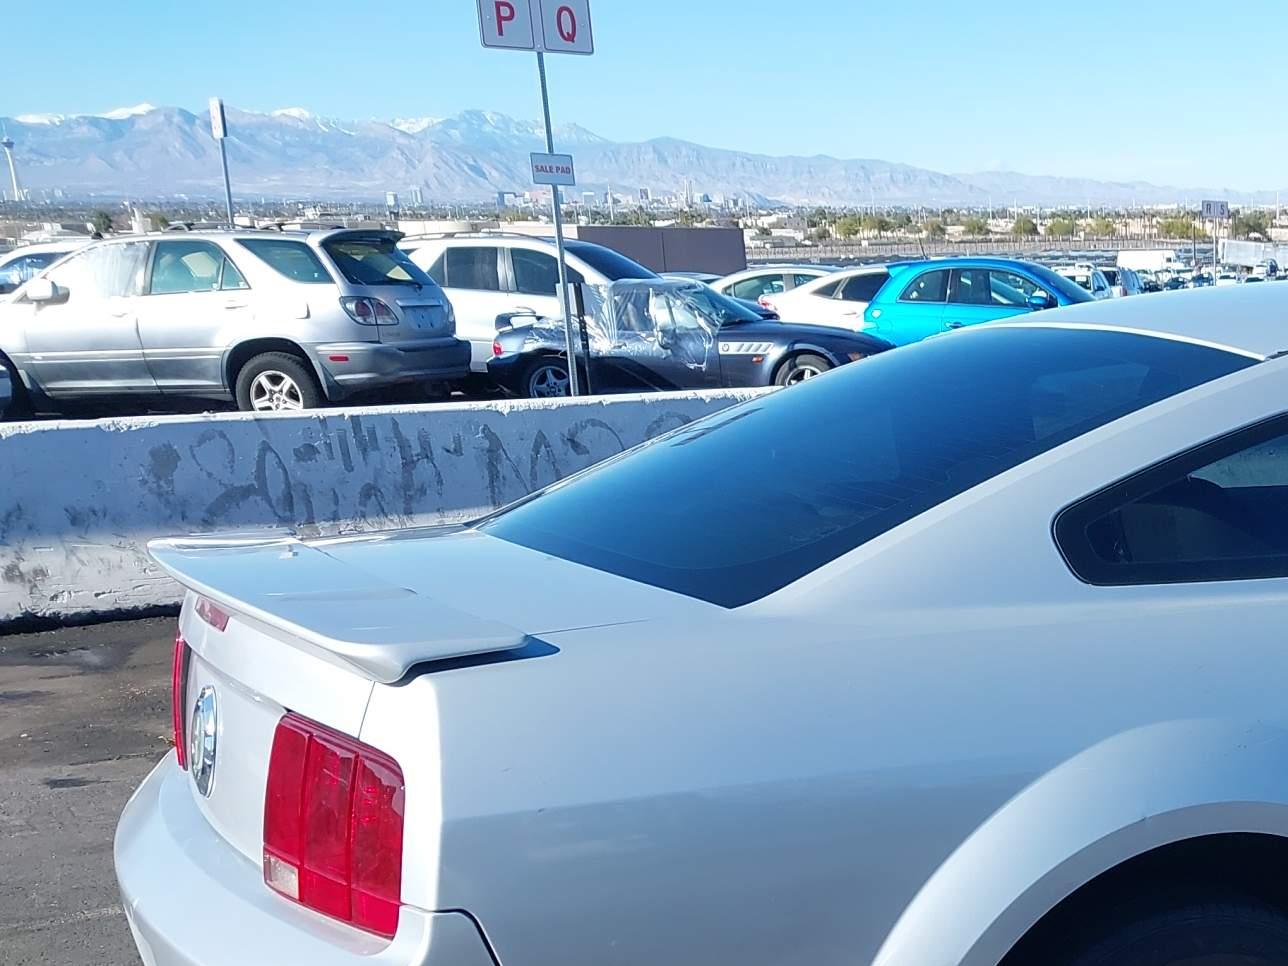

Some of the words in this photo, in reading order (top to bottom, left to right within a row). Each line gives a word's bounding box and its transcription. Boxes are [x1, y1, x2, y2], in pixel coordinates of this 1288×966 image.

[494, 1, 515, 36] P
[556, 6, 577, 43] Q
[534, 164, 553, 174] SALE
[555, 165, 571, 175] PAD
[1205, 203, 1212, 215] R
